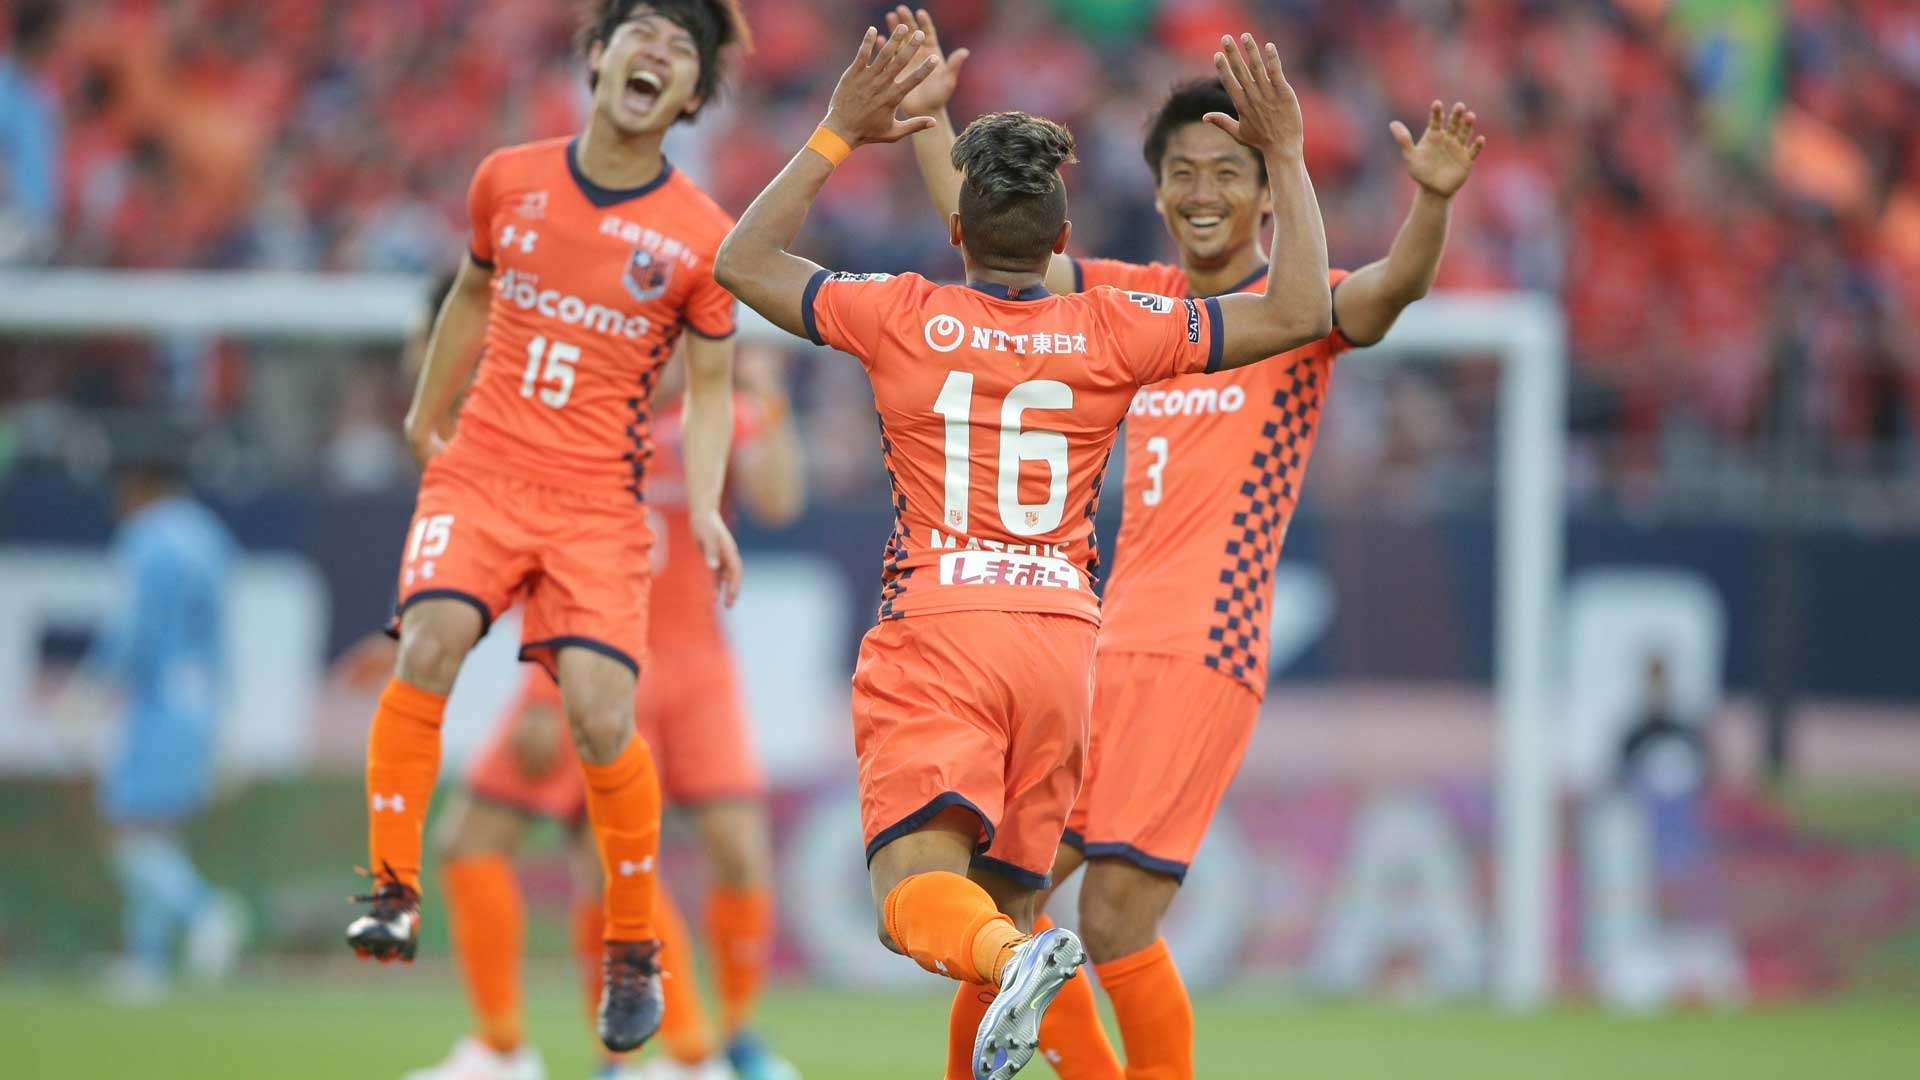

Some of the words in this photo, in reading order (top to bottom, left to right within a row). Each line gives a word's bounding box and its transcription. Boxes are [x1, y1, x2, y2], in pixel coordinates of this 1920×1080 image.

[520, 335, 581, 408] 15
[1128, 384, 1245, 417] ocomo
[933, 370, 1074, 537] 16
[1142, 436, 1169, 507] 3
[408, 514, 455, 562] 15
[952, 557, 1070, 587] しまむら
